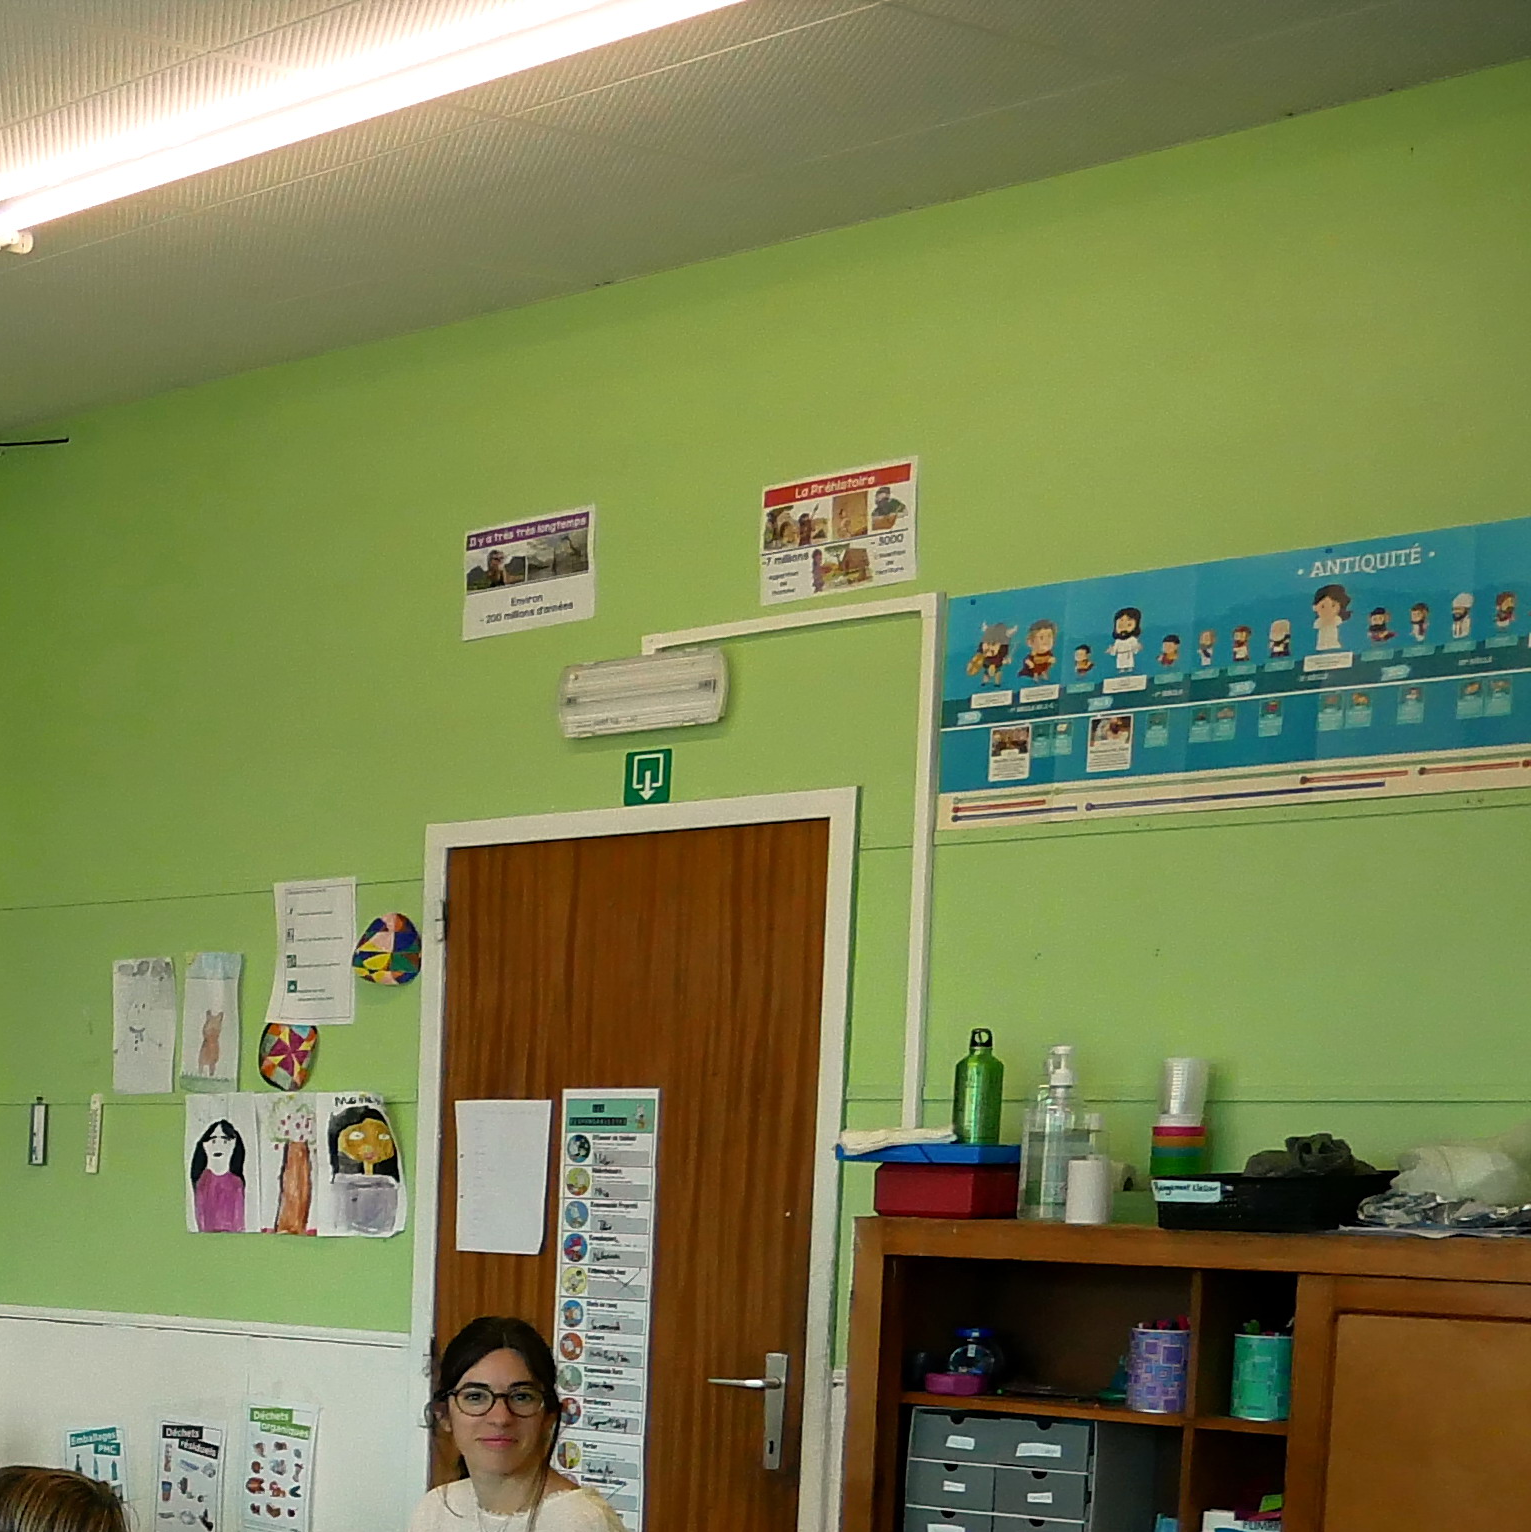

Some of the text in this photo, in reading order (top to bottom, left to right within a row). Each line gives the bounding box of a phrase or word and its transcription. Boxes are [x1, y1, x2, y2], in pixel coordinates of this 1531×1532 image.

[795, 487, 808, 499] La
[774, 551, 809, 565] millions
[1310, 542, 1422, 578] ANTIQUITÉ
[253, 1410, 289, 1422] Déchets
[165, 1427, 200, 1439] Déchets
[261, 1422, 310, 1439] organiques
[70, 1430, 117, 1447] Emballages
